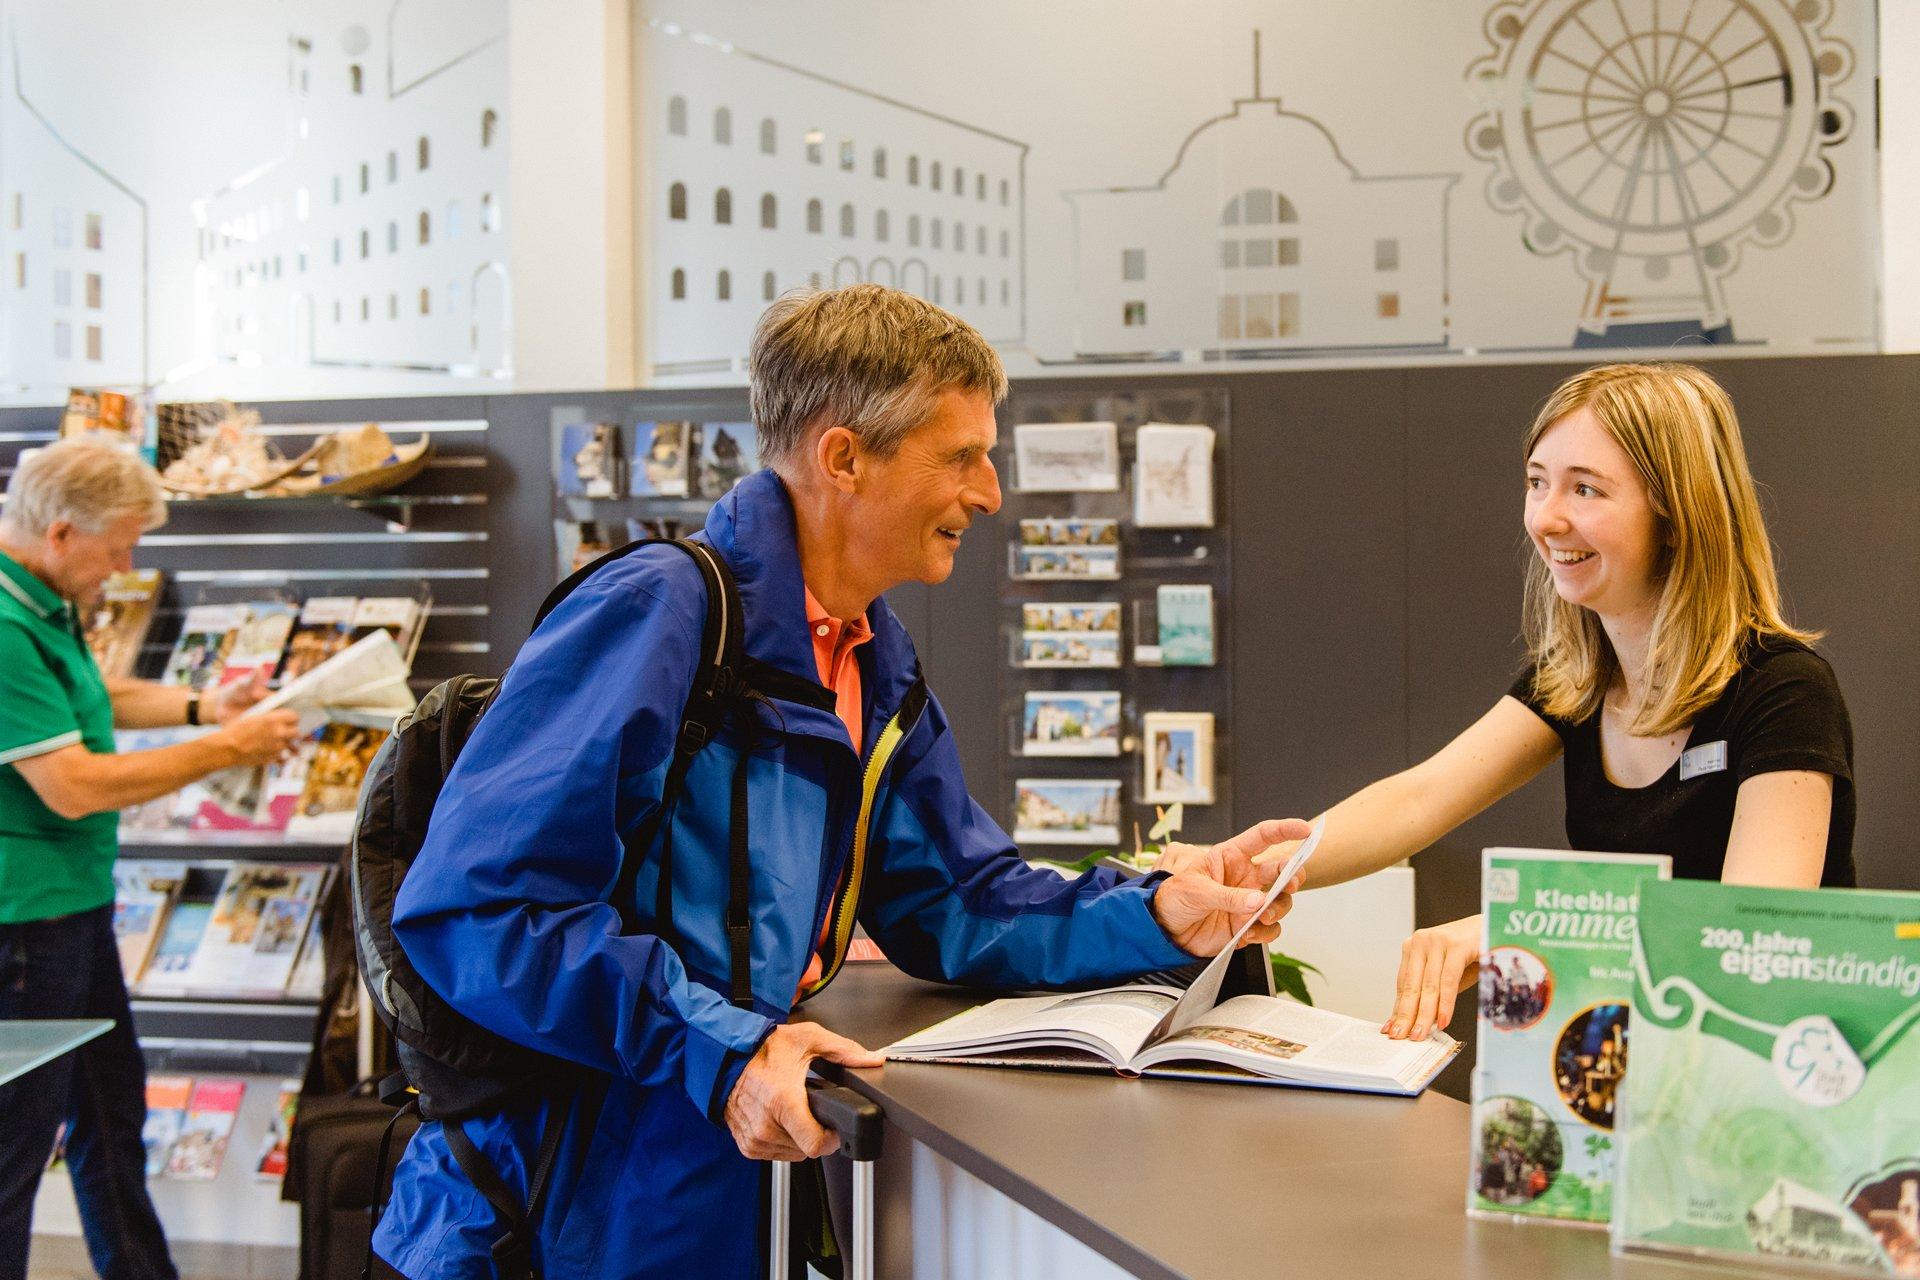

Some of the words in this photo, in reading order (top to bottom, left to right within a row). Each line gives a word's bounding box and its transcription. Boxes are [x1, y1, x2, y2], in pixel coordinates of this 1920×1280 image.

[1700, 926, 1744, 949] 200
[1752, 930, 1812, 955] Jahre
[1720, 943, 1920, 997] eigenständig
